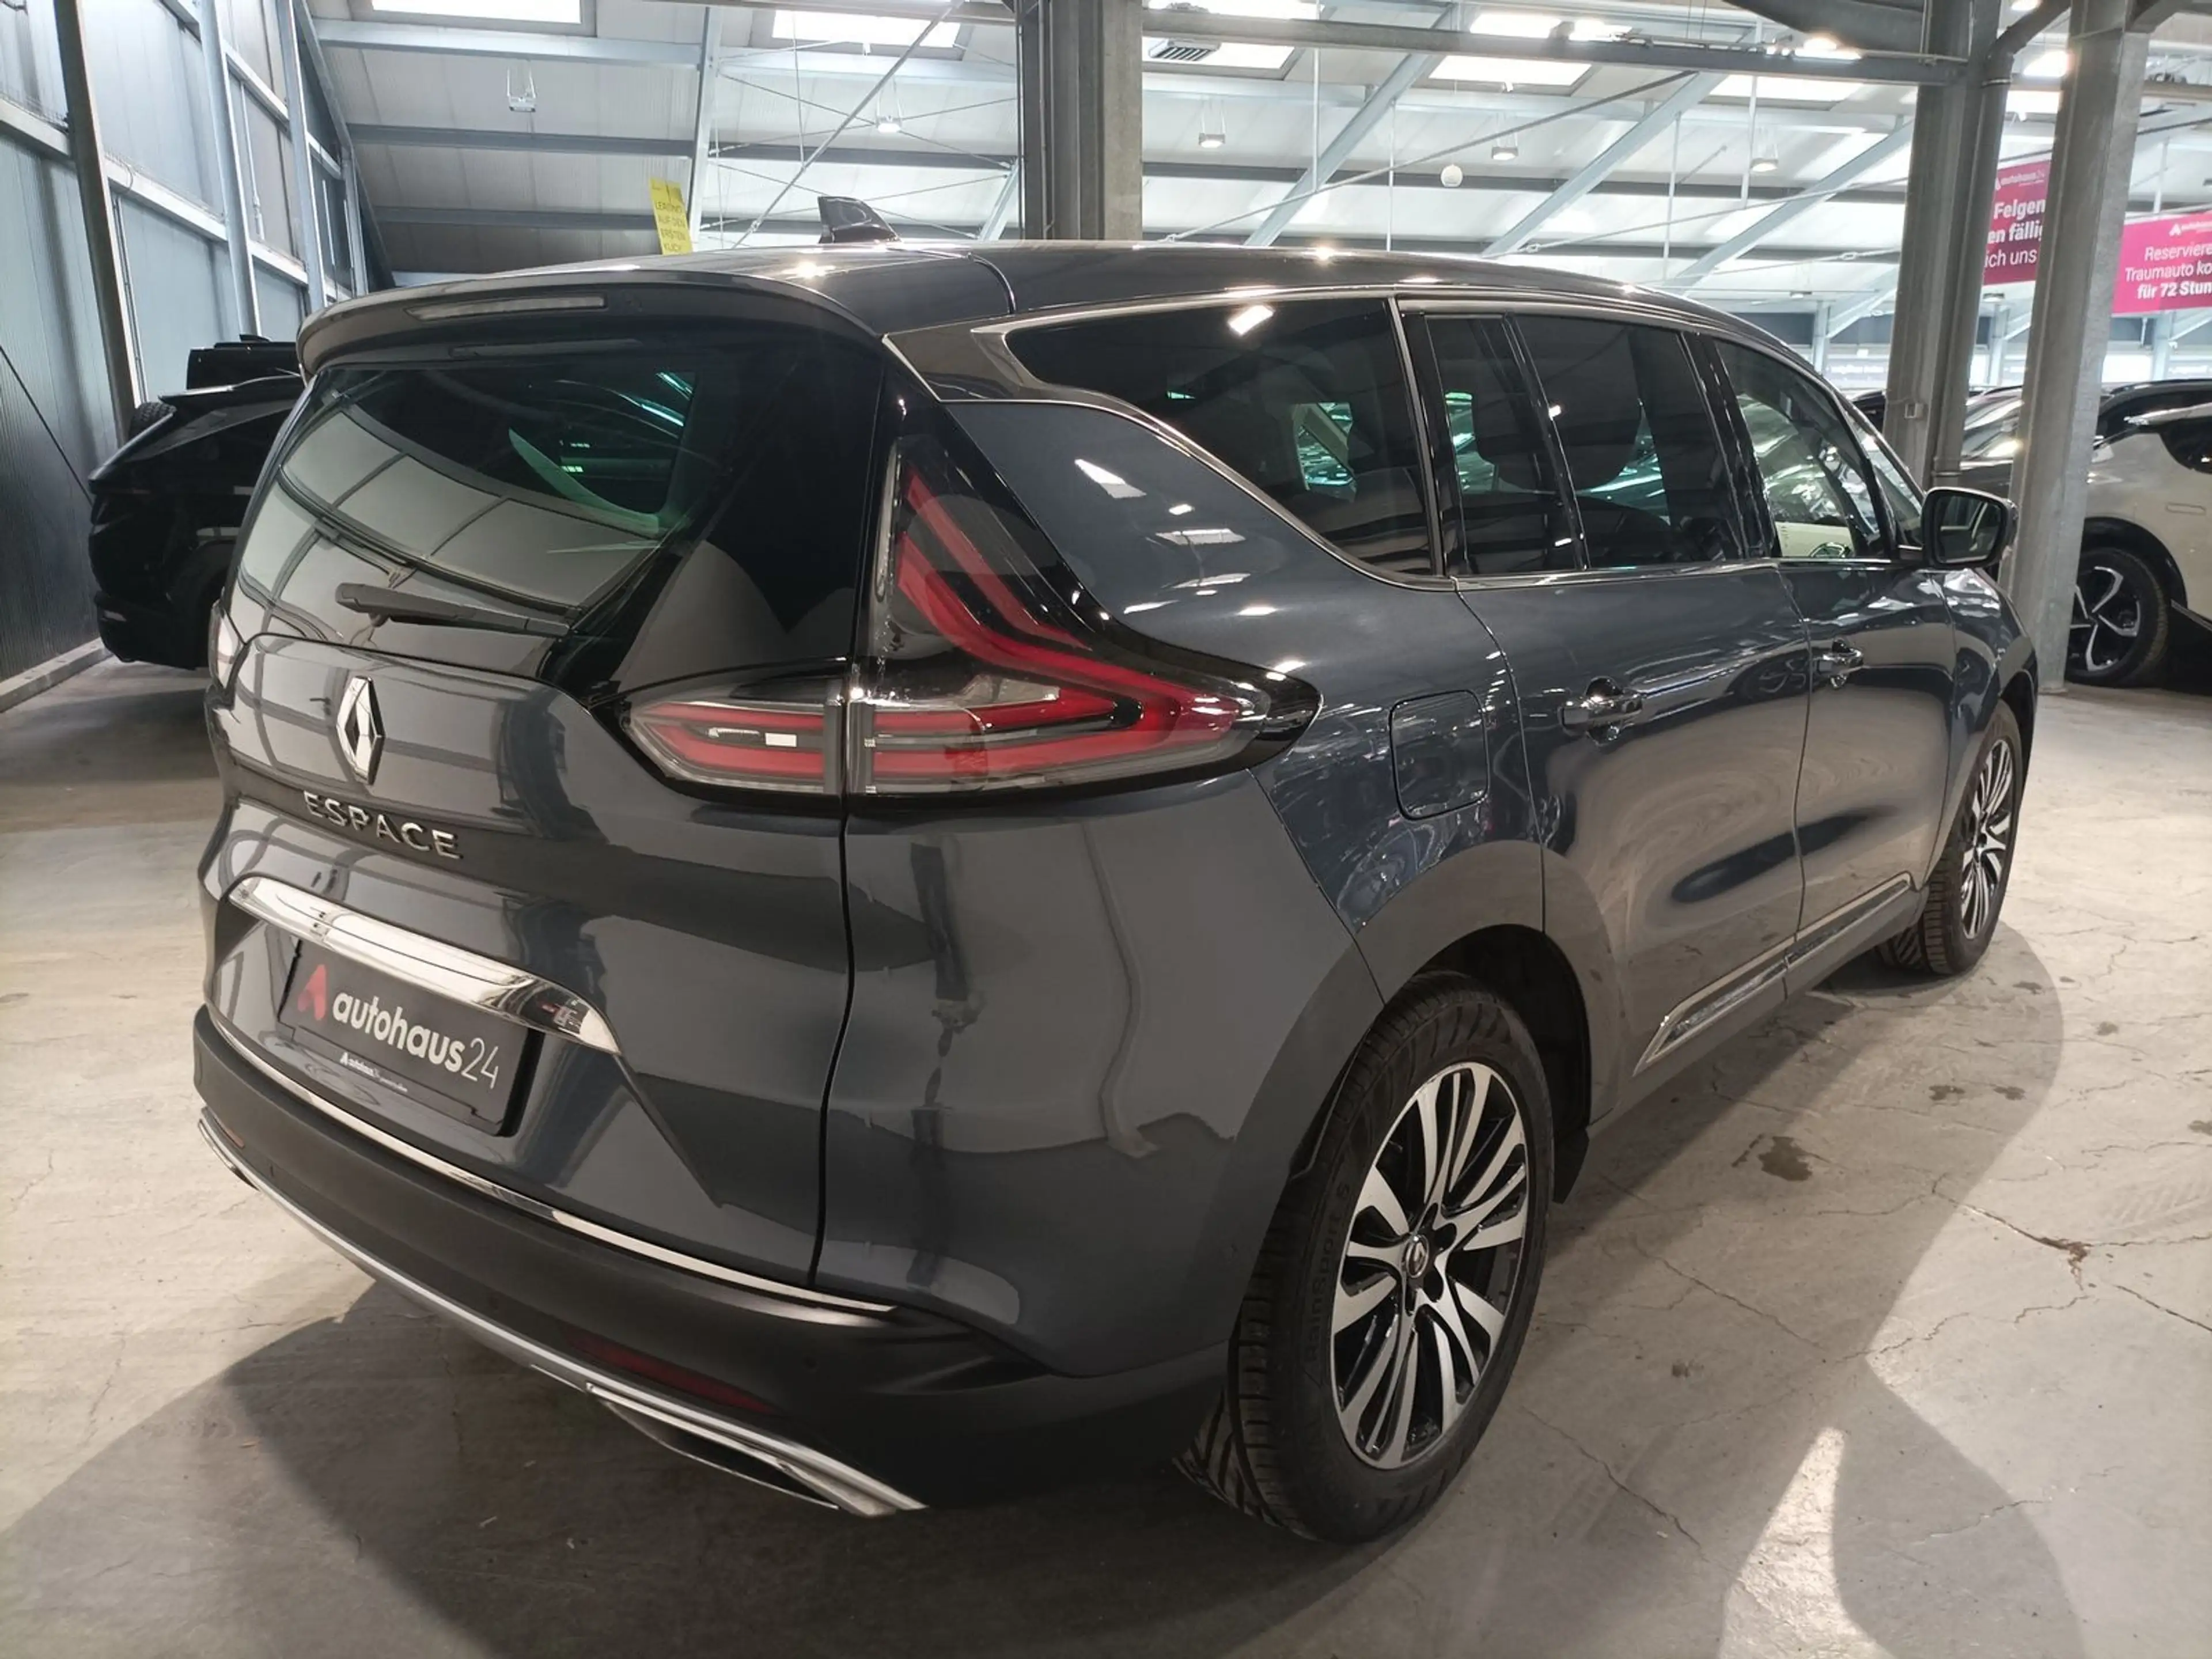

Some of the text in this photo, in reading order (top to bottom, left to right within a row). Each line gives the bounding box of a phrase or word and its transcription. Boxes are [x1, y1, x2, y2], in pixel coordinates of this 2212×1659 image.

[1994, 199, 2046, 220] Felgen
[2010, 249, 2037, 265] uns
[2125, 263, 2194, 282] Traumauto
[2137, 281, 2212, 299] für 72 Stun
[304, 790, 463, 859] ESPACE
[332, 992, 499, 1089] autohaus24
